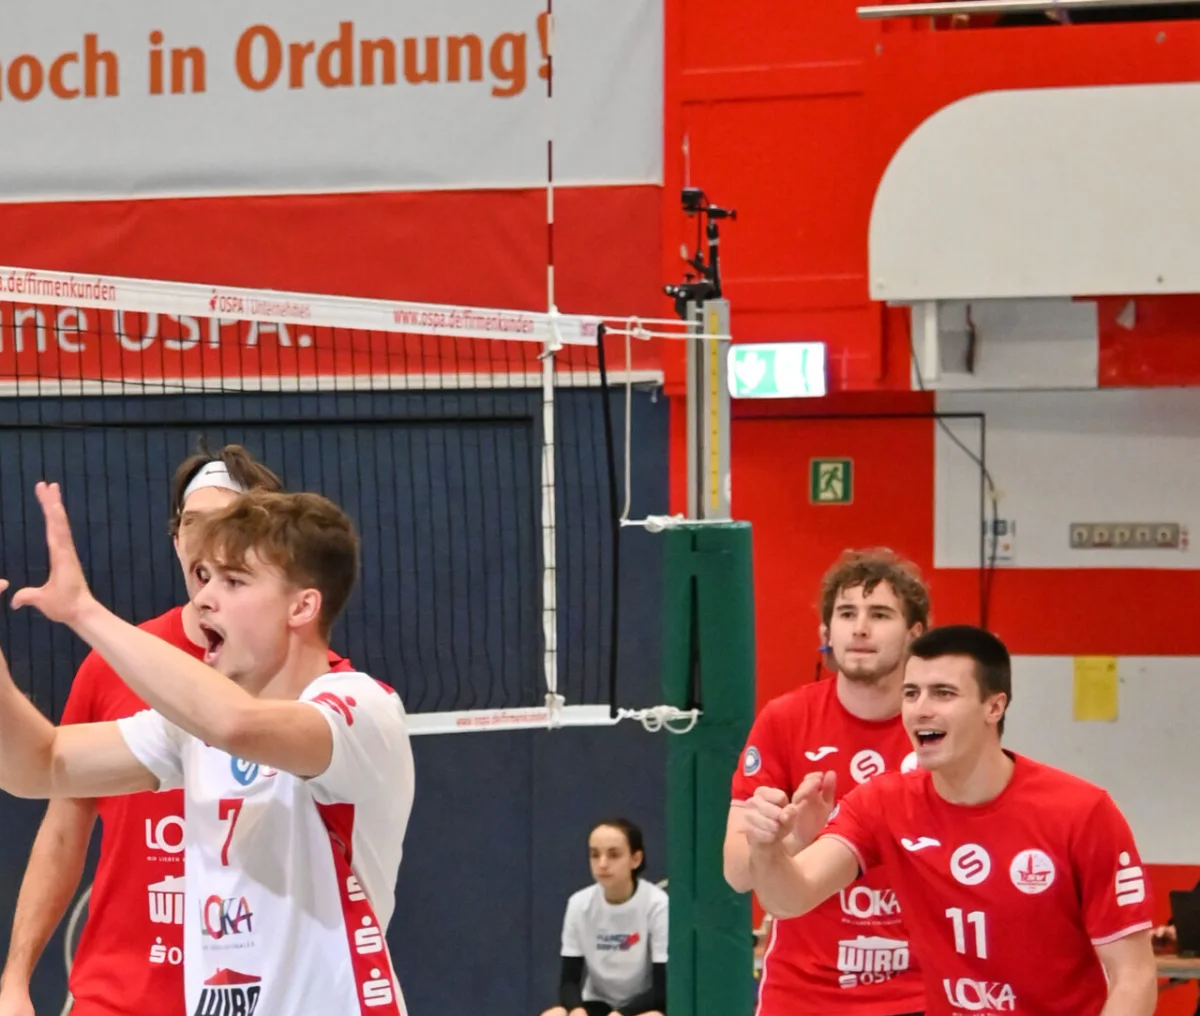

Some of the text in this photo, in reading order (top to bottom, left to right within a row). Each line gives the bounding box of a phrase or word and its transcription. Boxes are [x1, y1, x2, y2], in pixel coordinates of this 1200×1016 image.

[148, 30, 207, 96] in
[235, 13, 554, 98] Ordnung!
[219, 296, 244, 314] OSPA
[219, 798, 244, 867] 7
[198, 894, 254, 940] LOKA
[839, 885, 902, 919] LOKA
[945, 907, 988, 959] 11
[837, 946, 909, 973] WIRO
[943, 977, 1017, 1011] LOKA
